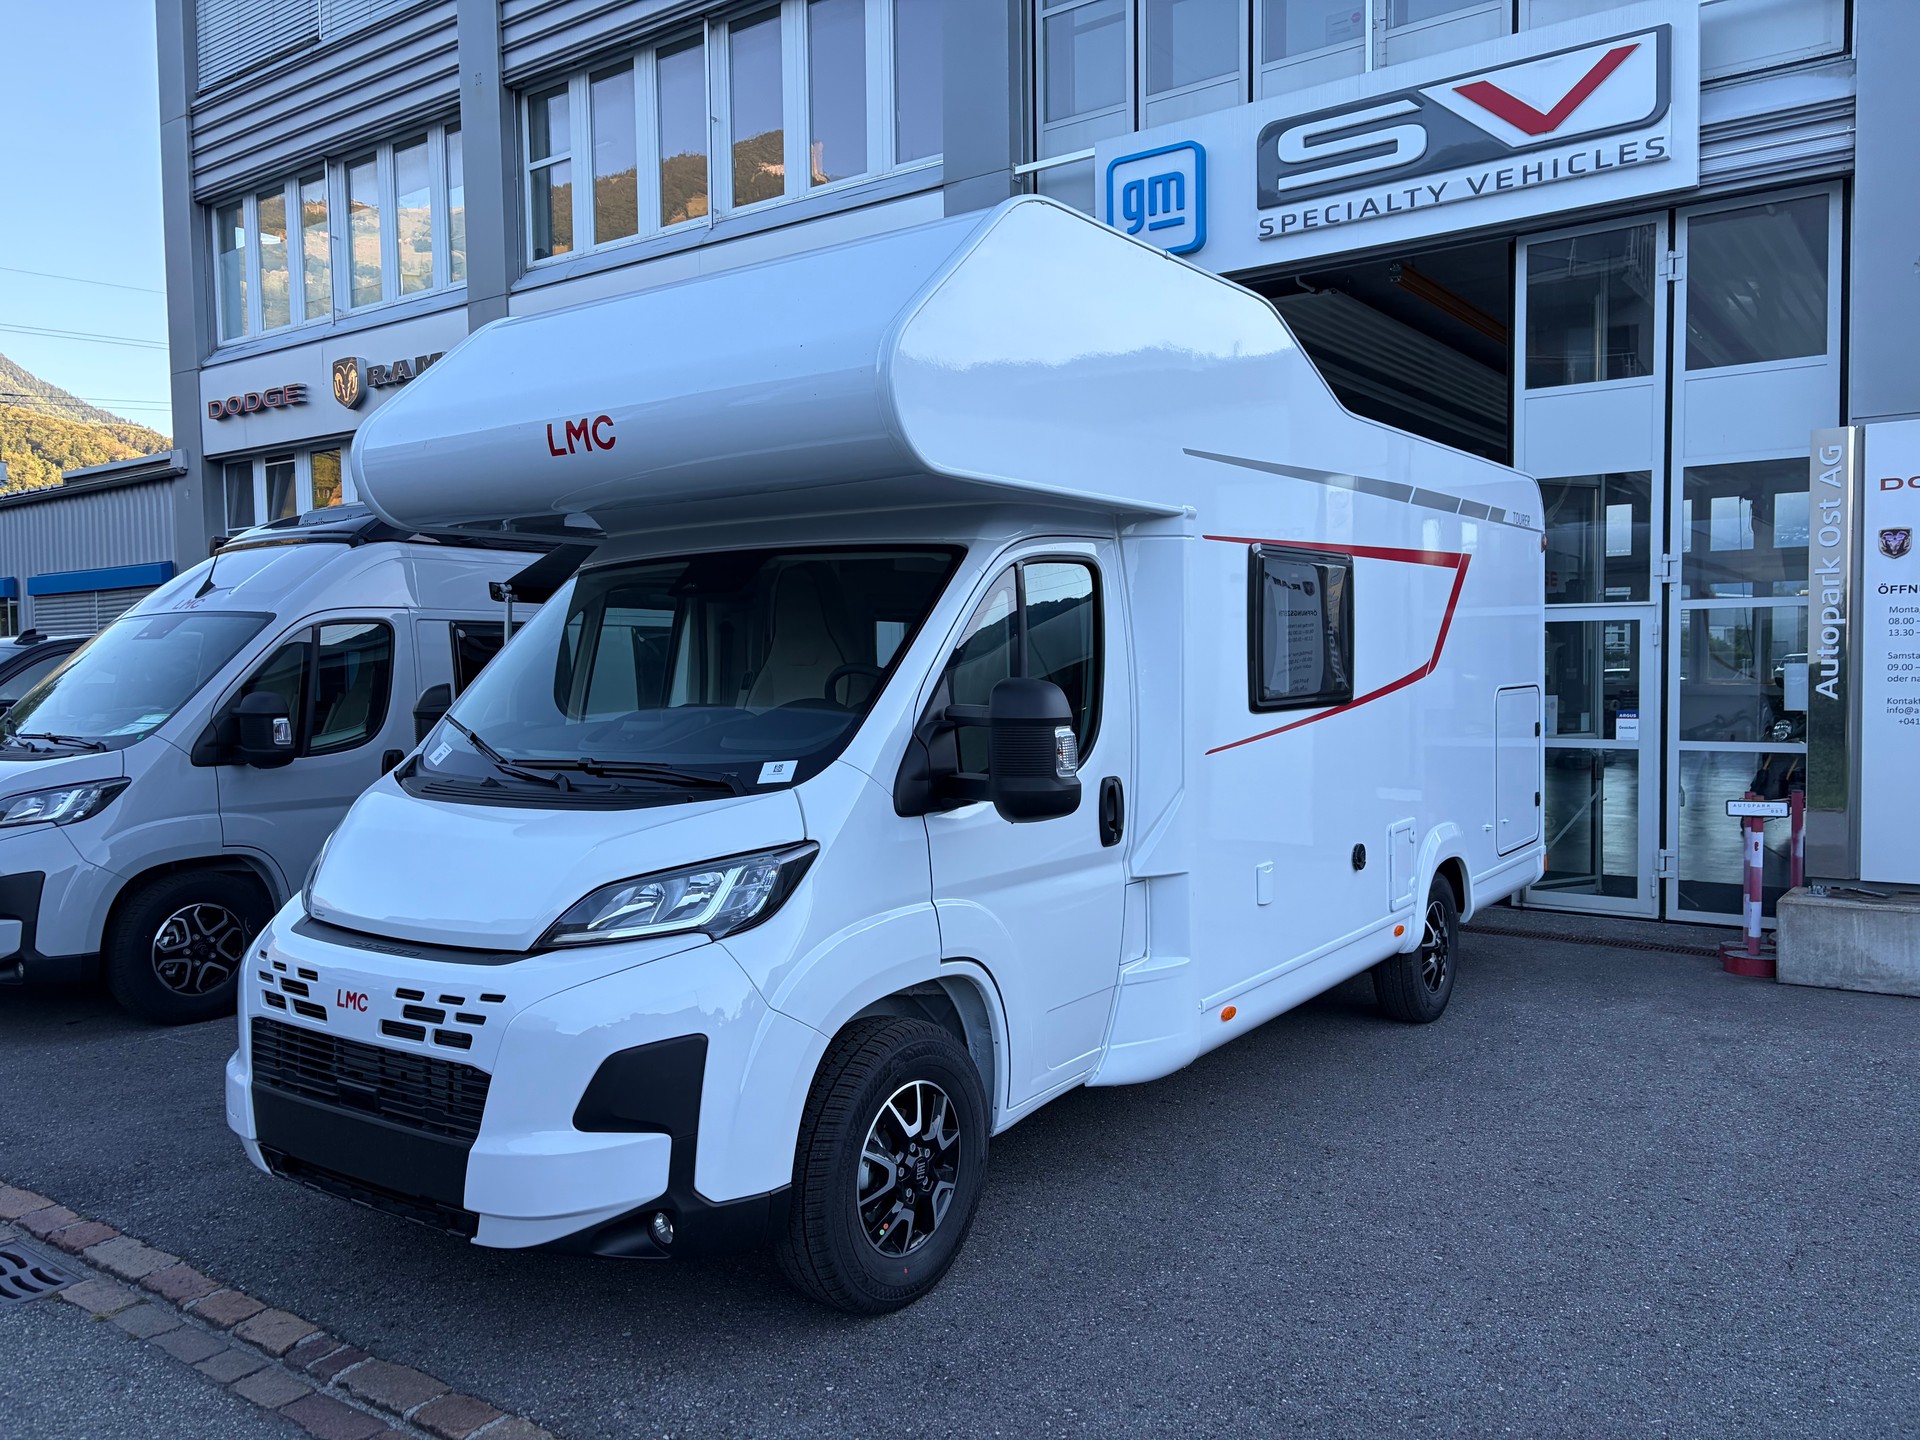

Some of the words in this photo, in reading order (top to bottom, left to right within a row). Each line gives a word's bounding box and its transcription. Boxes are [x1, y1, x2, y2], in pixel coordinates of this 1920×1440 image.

[1258, 181, 1448, 238] SPECIALTY
[1466, 136, 1666, 195] VEHICLES
[1122, 171, 1185, 235] gm
[207, 383, 306, 420] DODGE
[546, 414, 616, 457] LMC
[1819, 444, 1843, 488] AG
[1512, 512, 1531, 527] TOURER
[1818, 499, 1842, 548] Ost
[1877, 582, 1920, 595] ÖFFN
[171, 598, 206, 610] LMC
[1888, 606, 1920, 614] Monta
[1814, 557, 1846, 700] Autopark
[1888, 617, 1915, 625] 08.00
[1888, 628, 1915, 637] 13.30
[1887, 663, 1914, 671] 09.00
[1886, 674, 1909, 683] oder
[336, 988, 369, 1012] LMC
[916, 1161, 926, 1181] FIAT
